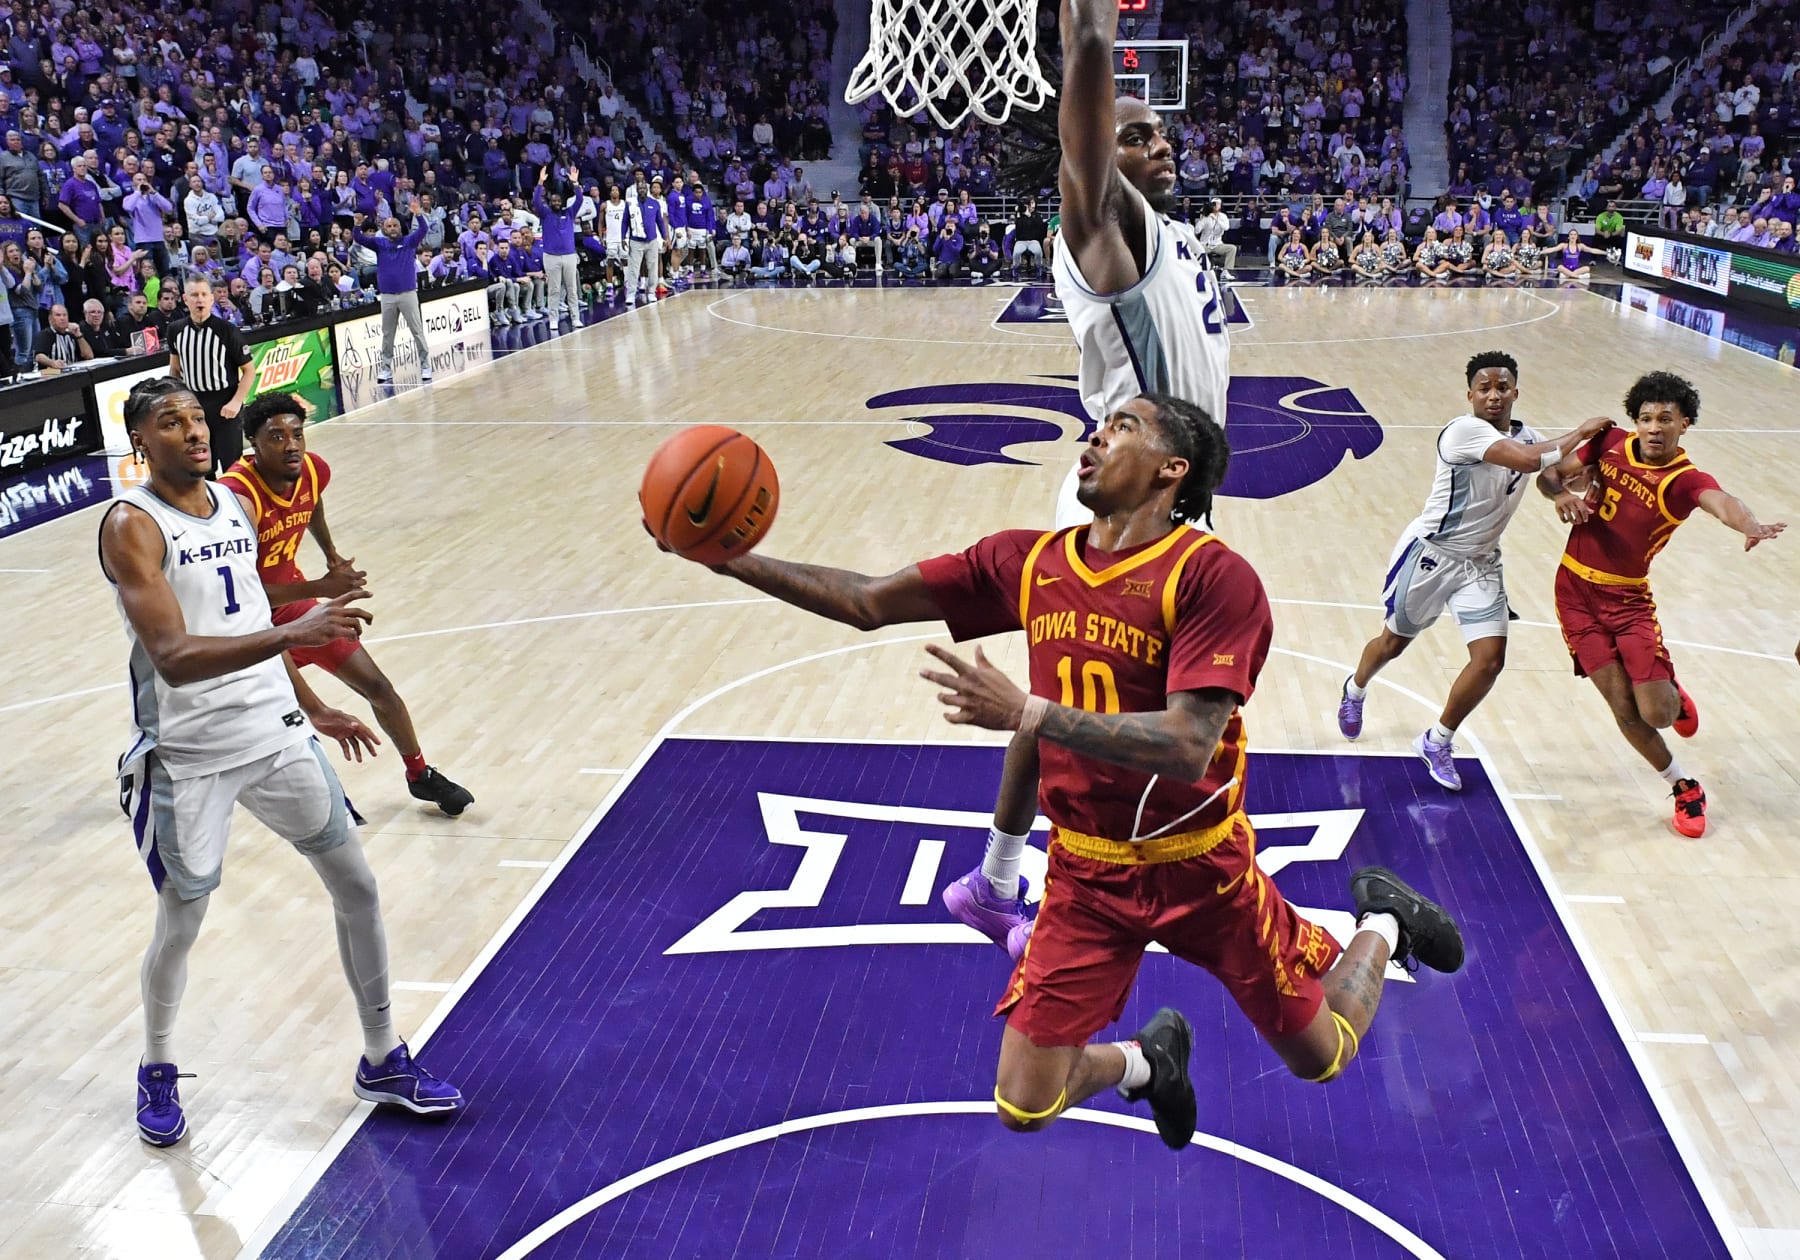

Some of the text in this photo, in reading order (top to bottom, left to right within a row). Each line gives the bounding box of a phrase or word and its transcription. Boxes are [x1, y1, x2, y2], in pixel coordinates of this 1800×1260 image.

[425, 315, 447, 333] TACO
[463, 305, 482, 323] BELL
[38, 416, 83, 455] Hut
[1599, 487, 1622, 521] 5
[1619, 472, 1656, 509] STATE
[179, 538, 253, 566] K-STATE
[263, 531, 298, 568] 24
[216, 565, 241, 616] 1
[1031, 610, 1164, 667] IOWA STATE
[1056, 655, 1121, 715] 10
